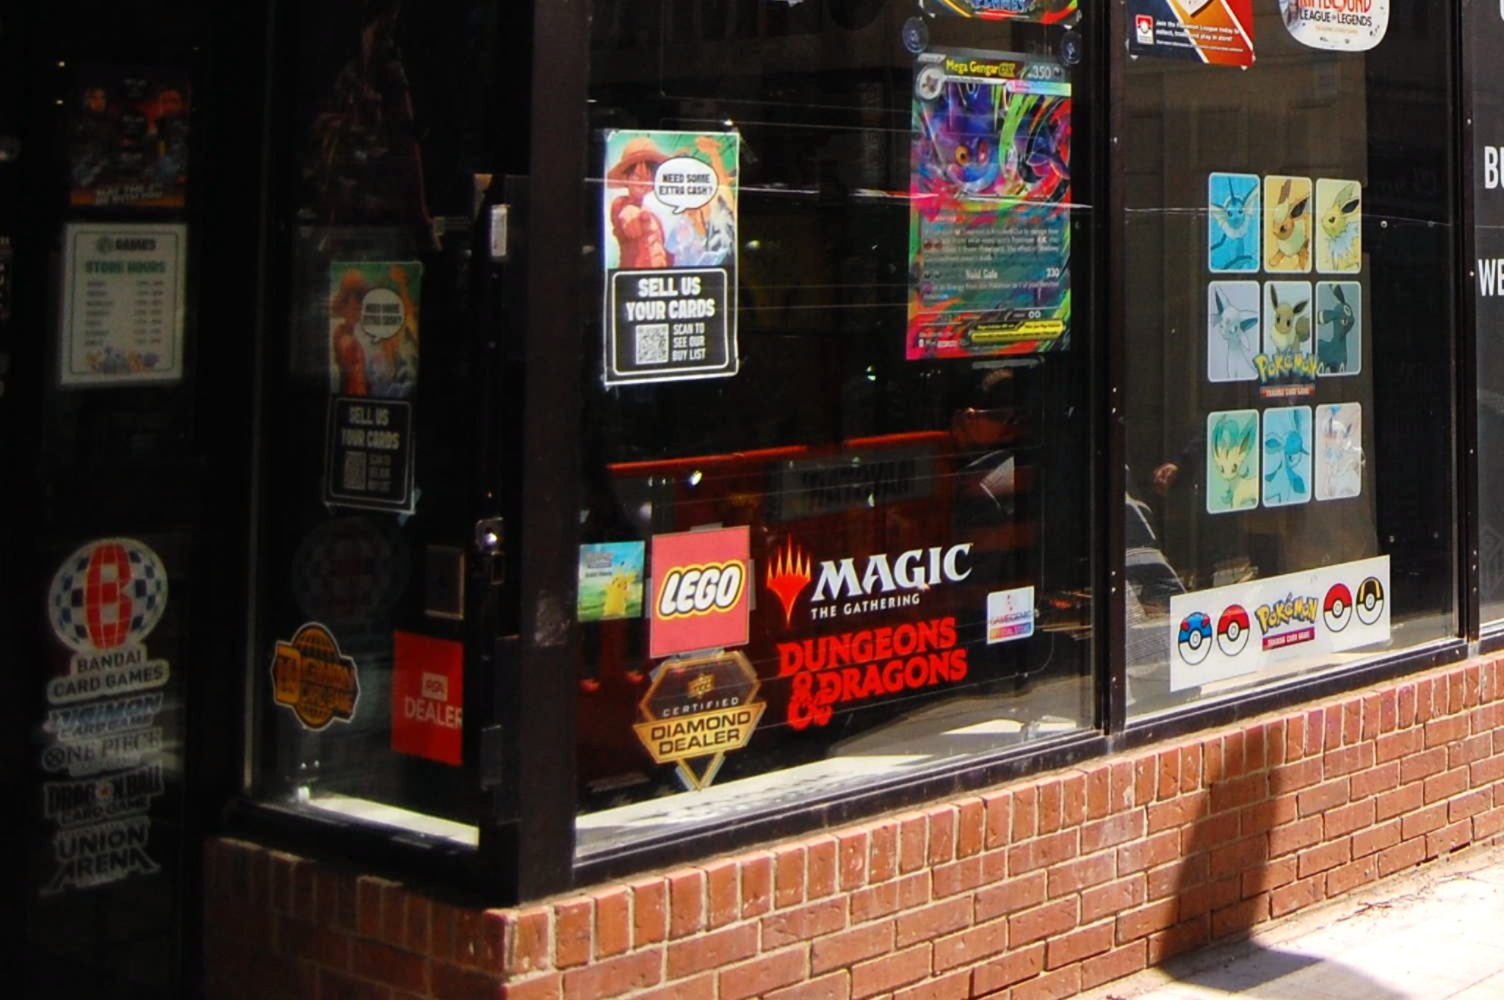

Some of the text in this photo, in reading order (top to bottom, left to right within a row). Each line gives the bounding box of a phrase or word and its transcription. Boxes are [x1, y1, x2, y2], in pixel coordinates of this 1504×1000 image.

[1299, 9, 1331, 23] LEAGUE
[1337, 13, 1373, 27] LEGENDS
[945, 60, 969, 75] Mega
[970, 60, 999, 77] Gengar
[1032, 66, 1051, 80] 350
[662, 171, 711, 186] NEED SOME
[659, 184, 713, 198] EXTRA CASH?
[85, 261, 125, 275] STORE
[637, 274, 702, 298] SELL US
[625, 297, 716, 322] YOUR CARDS
[672, 323, 705, 336] SCAN TO
[673, 336, 705, 349] SEE OUR
[672, 349, 706, 362] BUY LIST
[349, 405, 390, 427] SELL US
[341, 428, 400, 451] YOUR CARDS
[811, 542, 974, 603] MAGIC
[660, 563, 744, 615] LEGO
[811, 592, 921, 621] THE GATHERING
[776, 617, 958, 679] DUNGEONS
[77, 649, 142, 674] BANDAI
[53, 664, 164, 699] CARD GAMES
[816, 649, 969, 704] DRAGONS
[404, 696, 463, 729] DEALER
[662, 697, 740, 718] CERTIFIED
[651, 711, 752, 741] DIAMOND
[659, 728, 740, 756] DEALER
[56, 824, 145, 859] UNION
[45, 848, 156, 889] ARENA
